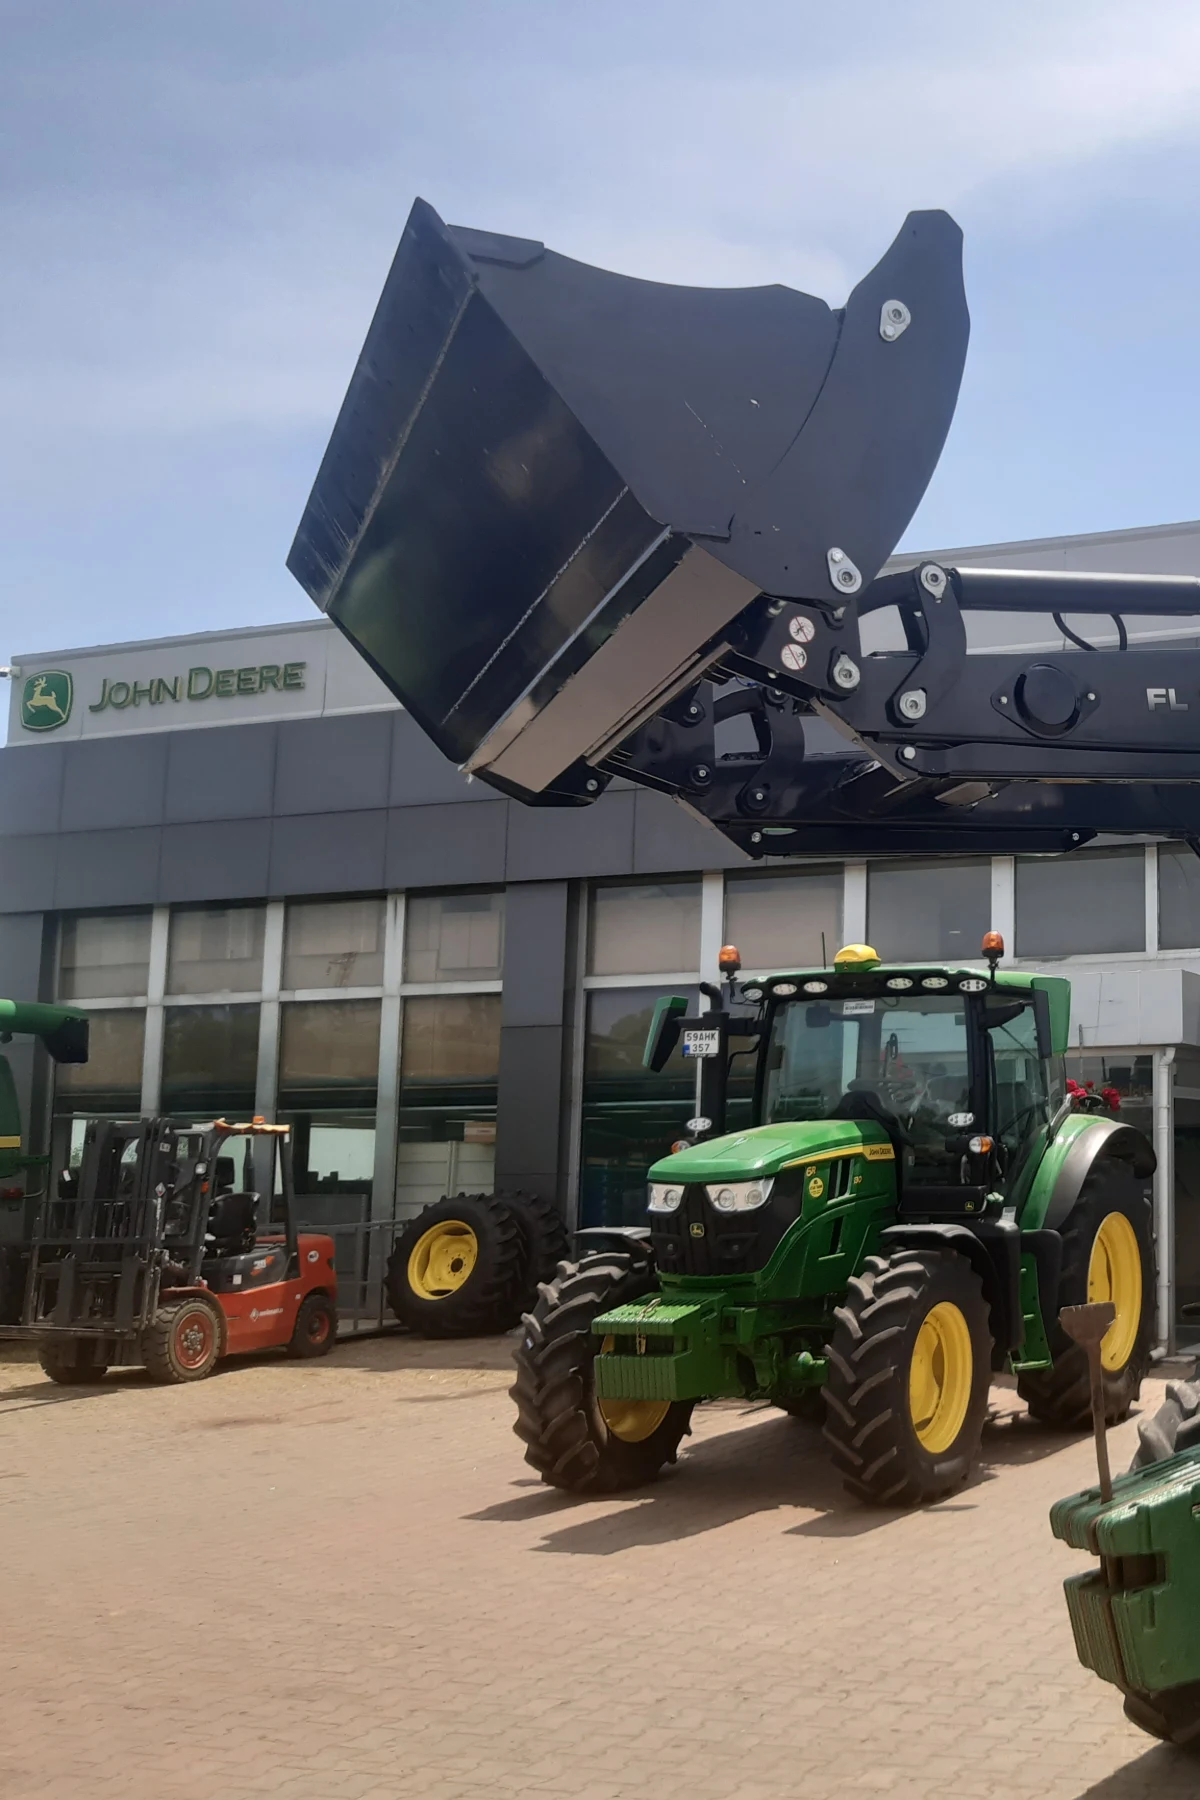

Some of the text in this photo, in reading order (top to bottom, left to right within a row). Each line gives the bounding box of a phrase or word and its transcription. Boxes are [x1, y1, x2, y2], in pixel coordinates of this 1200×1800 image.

[89, 661, 306, 712] JOHN DEERE
[1146, 688, 1188, 711] FL
[692, 1043, 710, 1052] 357
